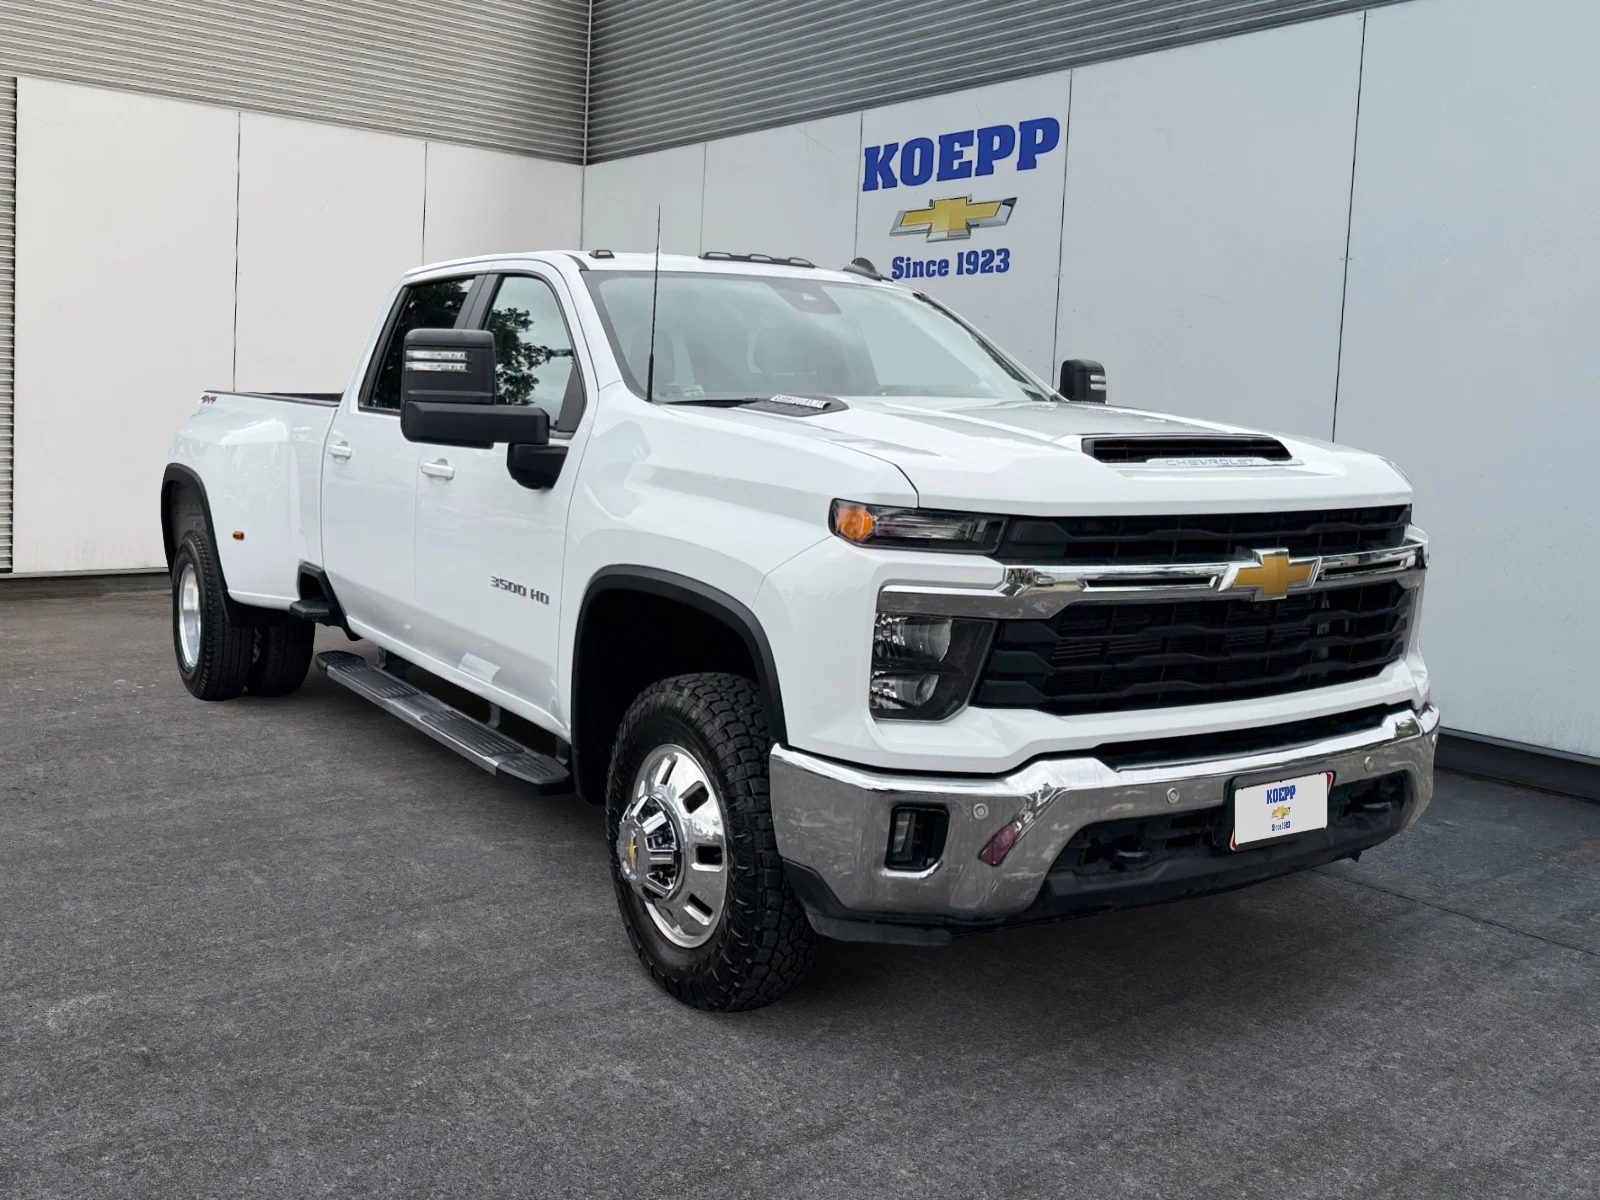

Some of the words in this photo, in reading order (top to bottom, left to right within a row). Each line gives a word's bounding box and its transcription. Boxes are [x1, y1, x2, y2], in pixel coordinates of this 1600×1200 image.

[862, 117, 1060, 192] KOEPP
[891, 256, 949, 279] Since
[956, 248, 1010, 275] 1923
[490, 576, 526, 597] 3500
[530, 588, 550, 605] HD
[1266, 785, 1296, 804] KOEPP
